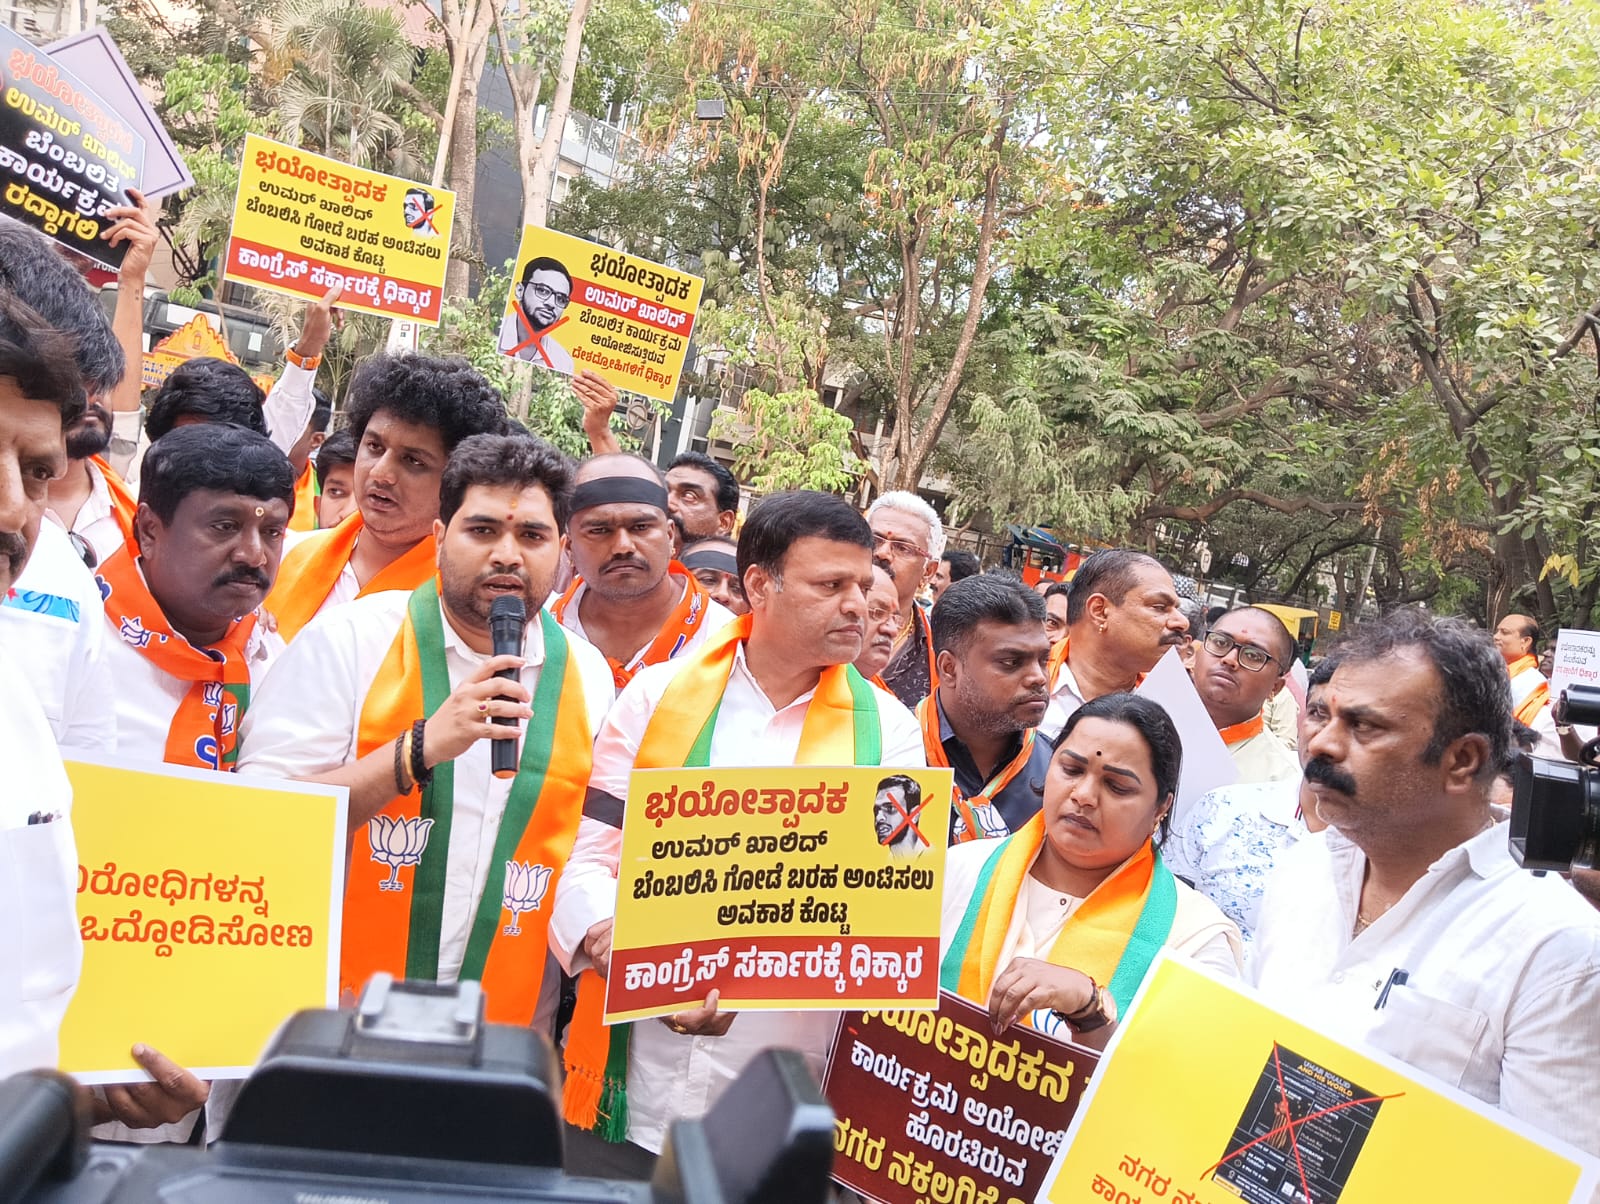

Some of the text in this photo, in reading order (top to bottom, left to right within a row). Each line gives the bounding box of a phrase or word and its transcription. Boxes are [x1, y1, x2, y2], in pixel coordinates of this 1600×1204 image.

[6, 87, 81, 136] ಉಮರ್
[25, 130, 120, 192] ಬೆಂಬಲಿತ
[255, 150, 388, 203] ಭಯೋತ್ಪಾದಕ
[5, 182, 98, 240] ರದ್ದಾಗಲಿ
[259, 180, 373, 221] ಉಮರ್ ಖಾಲಿದ್
[246, 197, 441, 260] ಬೆಂಬಲಿಸಿ ಗೋಡೆ ಬರಹ ಅಂಟಿಸಲು
[300, 234, 386, 274] ಅವಕಾಶ ಕೊಟ್ಟ
[590, 252, 691, 303] ಭಯೋತ್ಪಾದಕ
[237, 247, 431, 316] ಕಾಂಗ್ರೆಸ್ ಸರ್ಕಾರಕ್ಕೆ ಧಿಕ್ಕಾರ
[579, 308, 682, 352] ಬೆಂಬಲಿತ ಕಾರ್ಯಕ್ರಮ
[584, 285, 687, 328] ಉಮರ್ ಖಾಲಿದ್
[645, 369, 673, 389] ಧಿಕ್ಕಾರ
[644, 780, 850, 829] ಭಯೋತ್ಪಾದಕ
[651, 830, 828, 860] ಉಮರ್ ಖಾಲಿದ್
[632, 862, 935, 900] ಬೆಂಬಲಿಸಿ ಗೋಡೆ ಬರಹ ಅಂಟಿಸಲು
[80, 909, 313, 958] ಒದ್ದೋಡಿಸೋಣ
[716, 895, 851, 936] ಅವಕಾಶ ಕೊಟ್ಟ
[623, 941, 924, 994] ಕಾಂಗ್ರೆಸ್ ಸರ್ಕಾರಕ್ಕೆ ಧಿಕ್ಕಾರ
[850, 1040, 959, 1108] ಕಾರ್ಯಕ್ರಮ
[861, 1010, 1075, 1103] ಯೋತ್ಪಾದಕನ
[1297, 1064, 1353, 1097] AND HIS WORLD
[905, 1112, 1027, 1187] ಹೊರಟಿರುವ
[1118, 1154, 1172, 1197] ನಗರ
